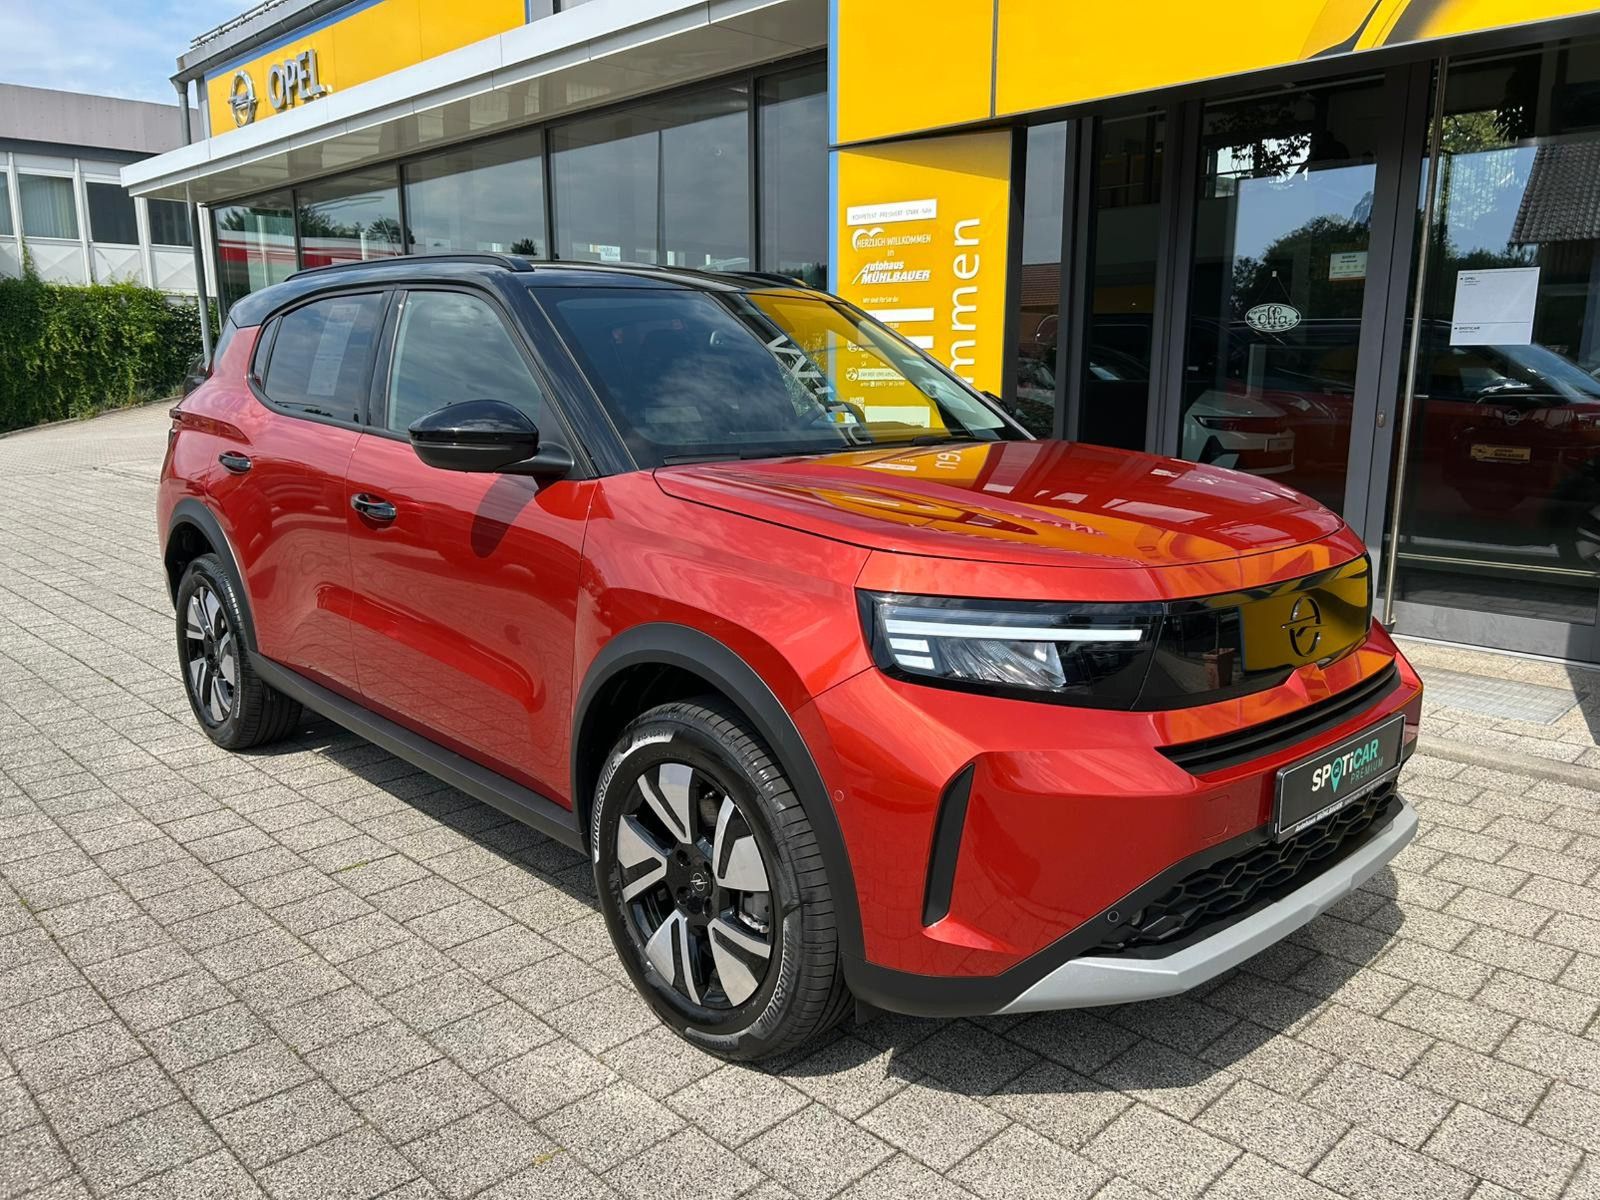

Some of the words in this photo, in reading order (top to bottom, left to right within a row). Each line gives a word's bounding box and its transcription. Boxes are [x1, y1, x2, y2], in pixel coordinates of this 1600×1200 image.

[269, 49, 325, 109] OPEL
[857, 236, 886, 248] HERZLICH
[887, 233, 931, 246] WILLKOMMEN
[861, 269, 931, 285] MÜHLBAUER
[1350, 756, 1384, 784] PREMIUM
